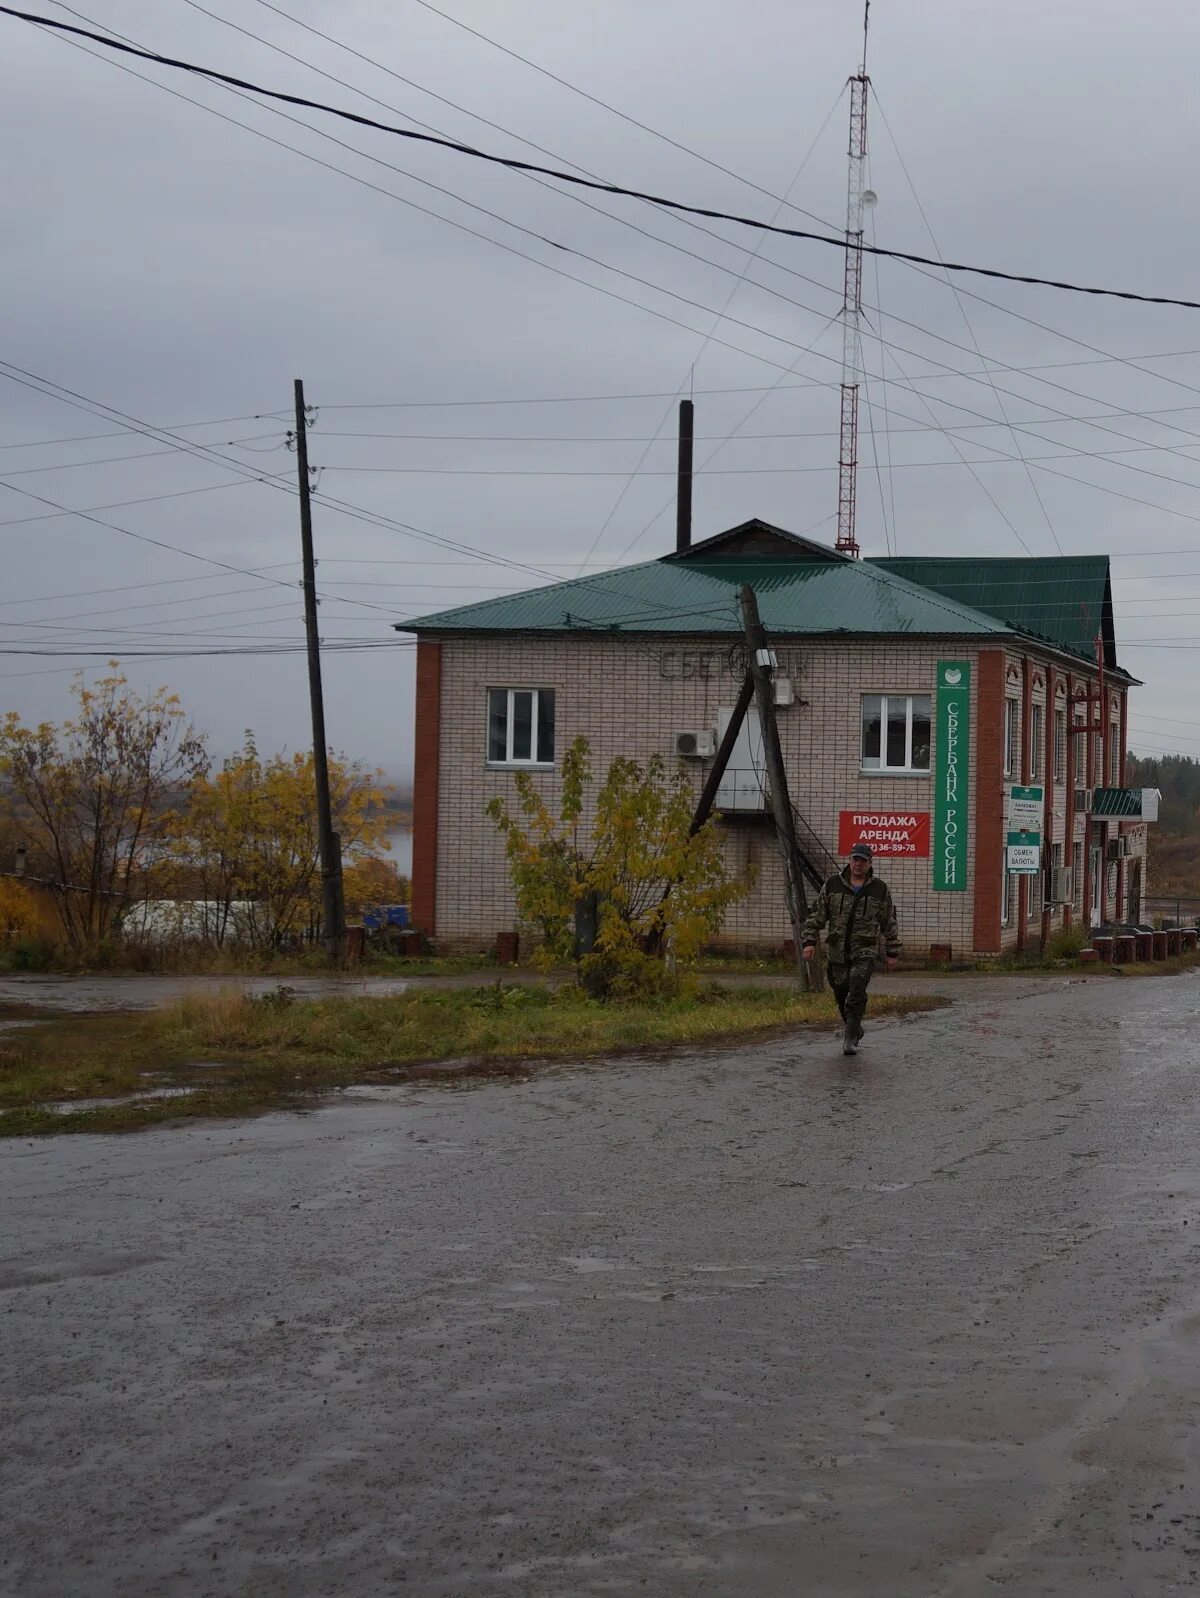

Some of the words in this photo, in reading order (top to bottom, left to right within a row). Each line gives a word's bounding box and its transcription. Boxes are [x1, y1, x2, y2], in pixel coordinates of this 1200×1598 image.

[945, 702, 959, 802] СБЕРБАНК
[853, 815, 917, 827] ПРОДАЖА
[859, 830, 909, 842] АРЕНДА
[879, 843, 916, 852] 36-89-78
[944, 809, 958, 884] РОССИИ
